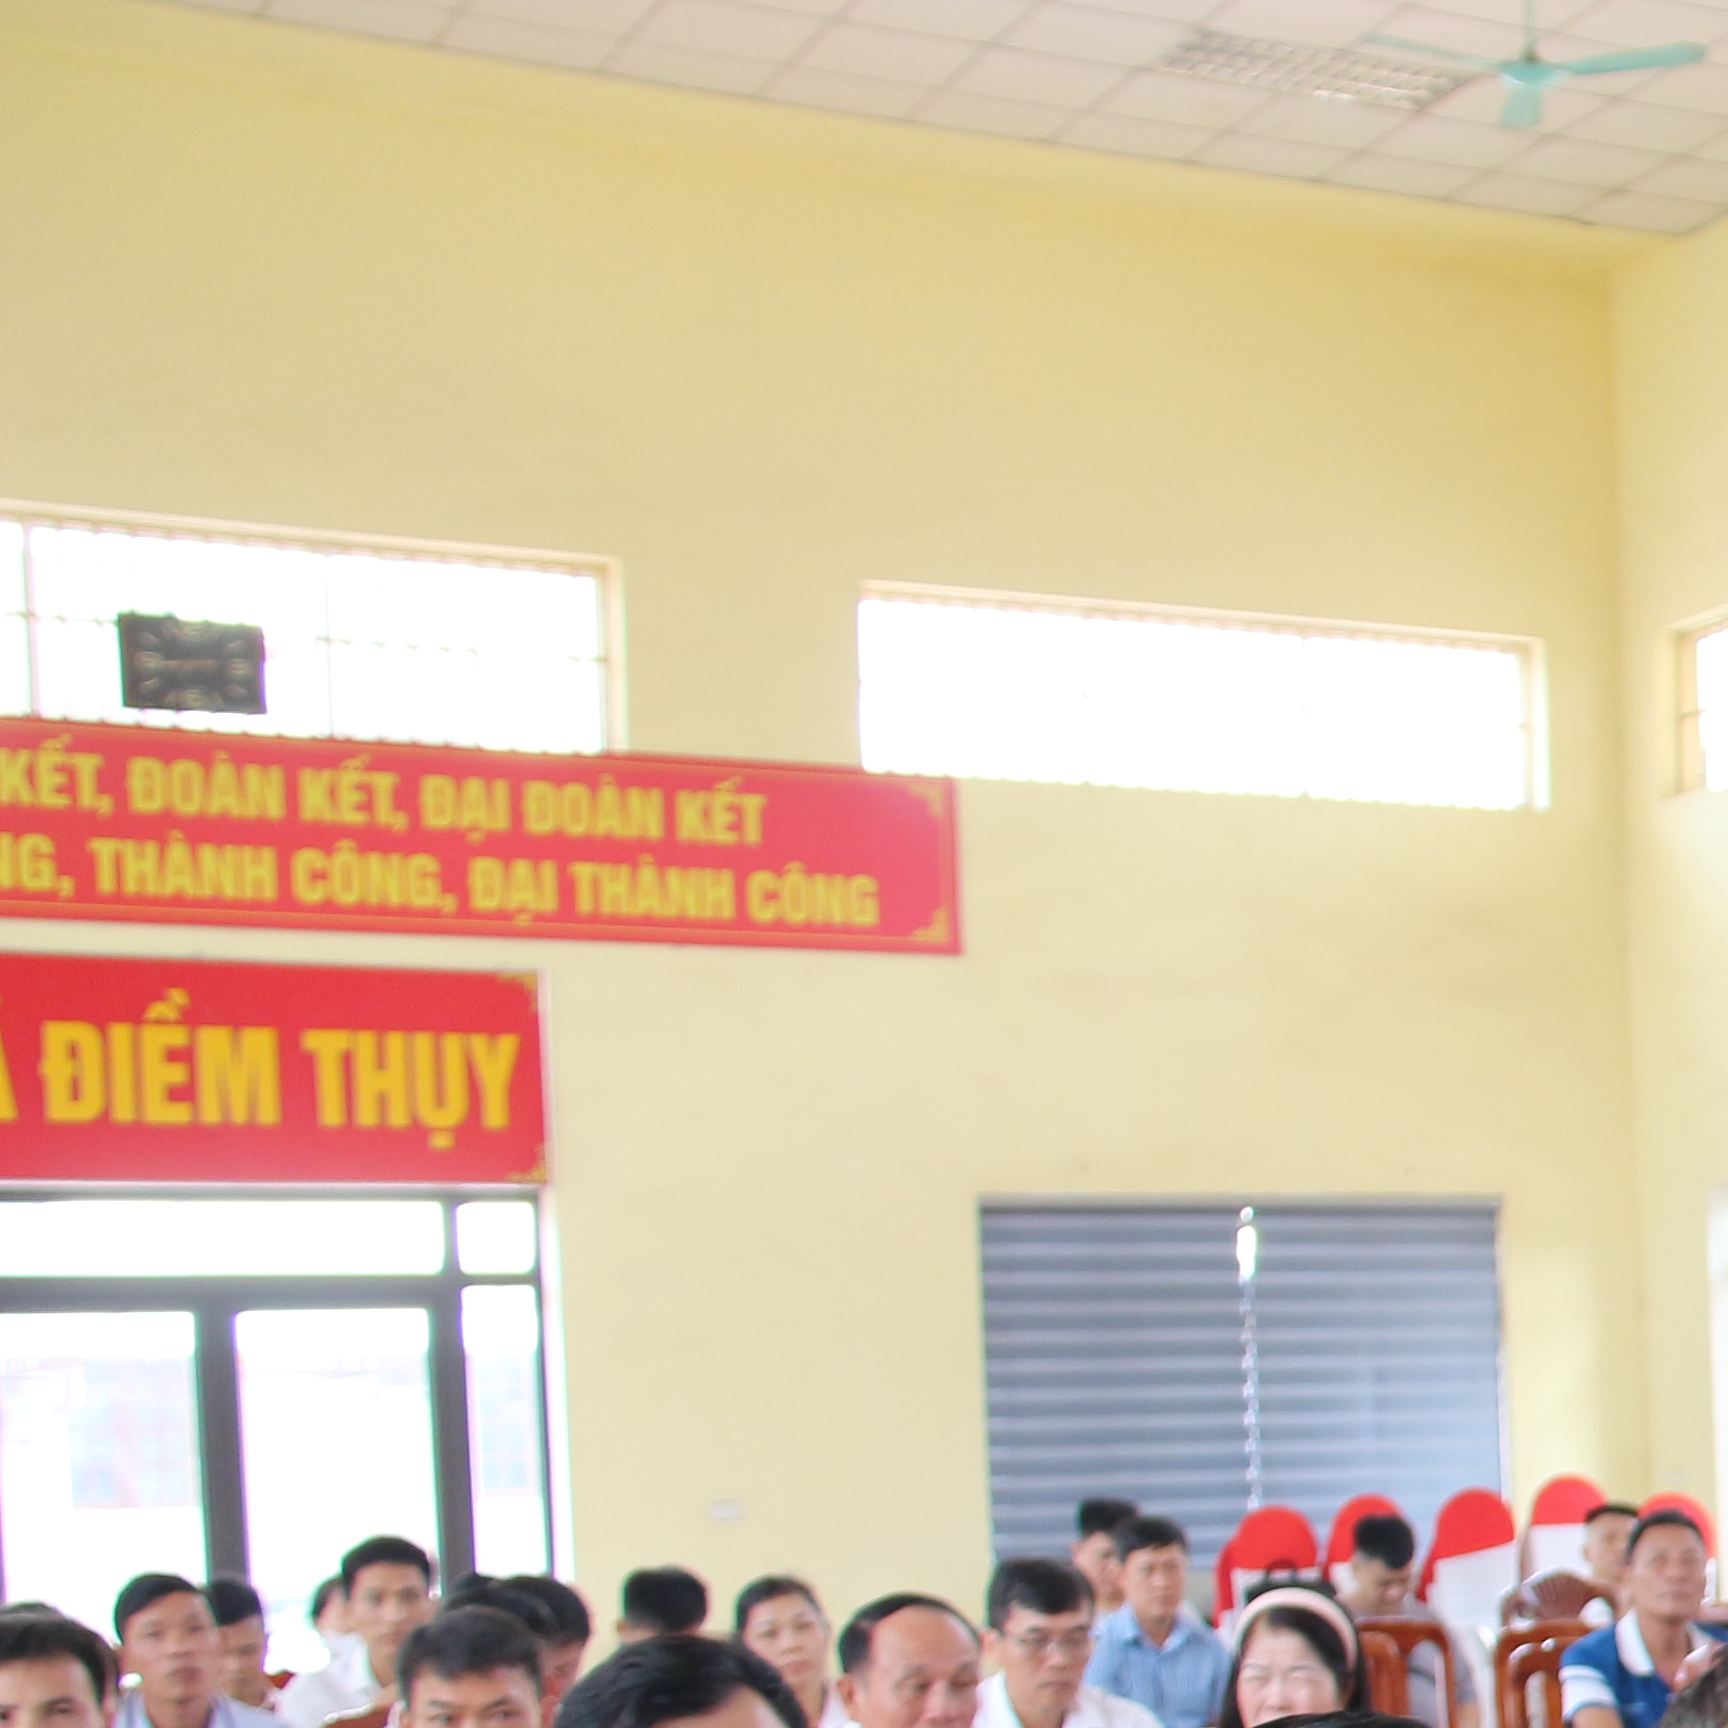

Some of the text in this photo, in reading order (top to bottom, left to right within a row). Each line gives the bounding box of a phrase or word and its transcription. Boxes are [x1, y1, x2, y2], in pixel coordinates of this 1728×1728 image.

[125, 748, 288, 823] ĐOÀN
[297, 752, 411, 834] KẾT,
[417, 772, 514, 845] ĐẠI
[520, 771, 667, 844] ĐOÀN
[674, 775, 768, 847] KẾT
[86, 829, 281, 904] THÀNH
[289, 837, 460, 917] CÔNG,
[466, 855, 561, 930] ĐẠI
[567, 853, 738, 923] THÀNH
[745, 861, 881, 929] CÔNG
[40, 986, 282, 1127] ĐIỂM
[302, 1027, 522, 1150] THỤY
